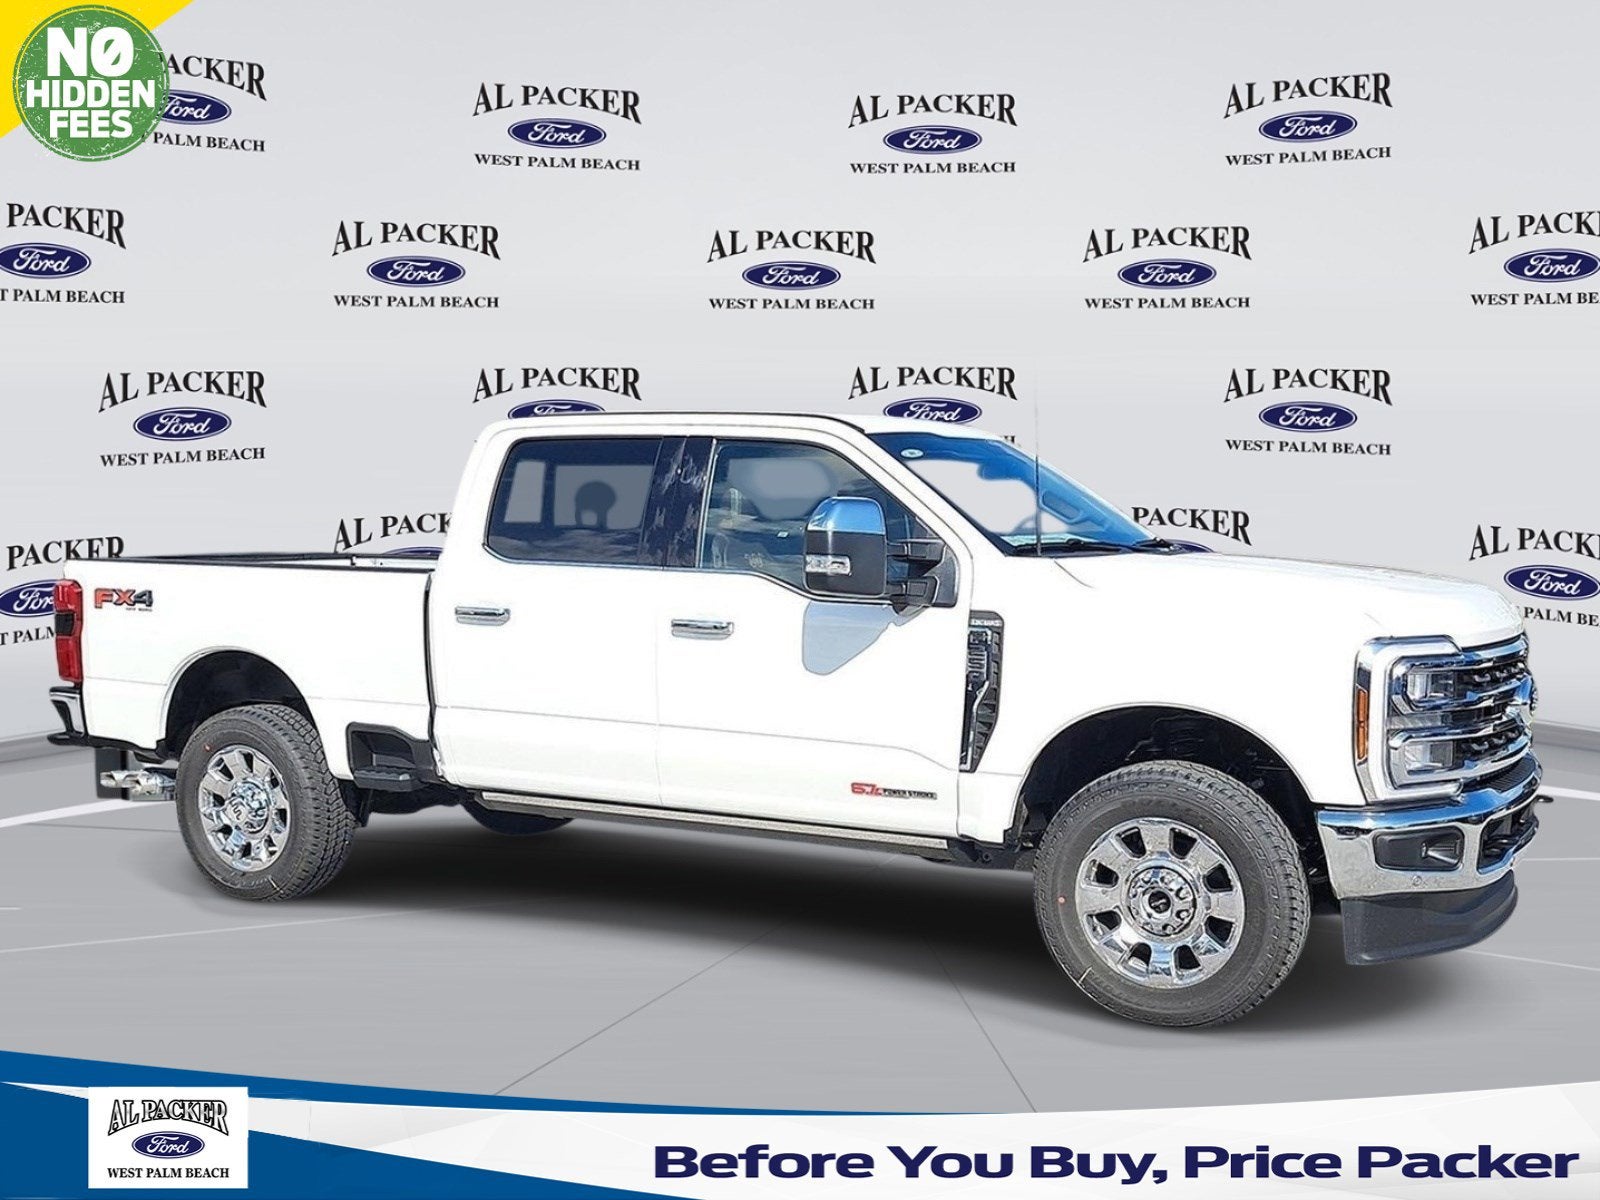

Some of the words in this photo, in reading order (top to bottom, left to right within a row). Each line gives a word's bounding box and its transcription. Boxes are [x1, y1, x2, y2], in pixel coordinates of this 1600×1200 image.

[167, 53, 267, 102] ACKER
[472, 82, 514, 117] AL
[521, 84, 642, 125] PACKER
[847, 94, 889, 129] AL
[896, 93, 1018, 127] PACKER
[1223, 82, 1265, 119] AL
[1272, 72, 1393, 108] PACKER
[153, 131, 202, 148] PALM
[206, 136, 265, 152] BEACH
[1225, 153, 1275, 166] WEST
[1278, 150, 1327, 164] PALM
[1332, 146, 1391, 161] BEACH
[474, 153, 524, 167] WEST
[527, 156, 576, 169] PALM
[581, 157, 640, 171] BEACH
[849, 163, 898, 174] WEST
[903, 162, 952, 174] PALM
[957, 161, 1016, 173] BEACH
[6, 202, 127, 250] PACKER
[331, 220, 373, 257] AL
[380, 221, 501, 261] PACKER
[1468, 215, 1510, 255] AL
[1517, 210, 1600, 238] PACK
[706, 230, 748, 264] AL
[756, 230, 877, 265] PACKER
[1082, 228, 1124, 263] AL
[1131, 225, 1252, 261] PACKER
[13, 288, 62, 303] PALM
[65, 290, 125, 304] BEACH
[333, 294, 383, 307] WEST
[387, 295, 435, 308] PALM
[440, 296, 499, 308] BEACH
[708, 298, 758, 310] WEST
[762, 298, 810, 310] PALM
[815, 298, 875, 310] BEACH
[1084, 297, 1134, 309] WEST
[1137, 297, 1186, 309] PALM
[1191, 296, 1250, 309] BEACH
[1470, 293, 1520, 306] WEST
[1523, 292, 1572, 305] PALM
[98, 372, 140, 414] AL
[146, 370, 267, 409] PACKER
[472, 368, 514, 403] AL
[521, 367, 642, 401] PACKER
[847, 366, 889, 401] AL
[897, 366, 1018, 401] PACKER
[1223, 368, 1265, 403] AL
[1272, 368, 1393, 406] PACKER
[100, 452, 149, 467] WEST
[153, 450, 202, 465] PALM
[206, 447, 266, 462] BEACH
[1225, 439, 1275, 452] WEST
[1278, 440, 1327, 453] PALM
[1332, 442, 1391, 456] BEACH
[333, 517, 373, 554] AL
[380, 511, 452, 539] PACK
[1468, 524, 1510, 562] AL
[1517, 527, 1600, 561] PACK
[94, 588, 153, 609] FX4
[1523, 606, 1572, 624] PALM
